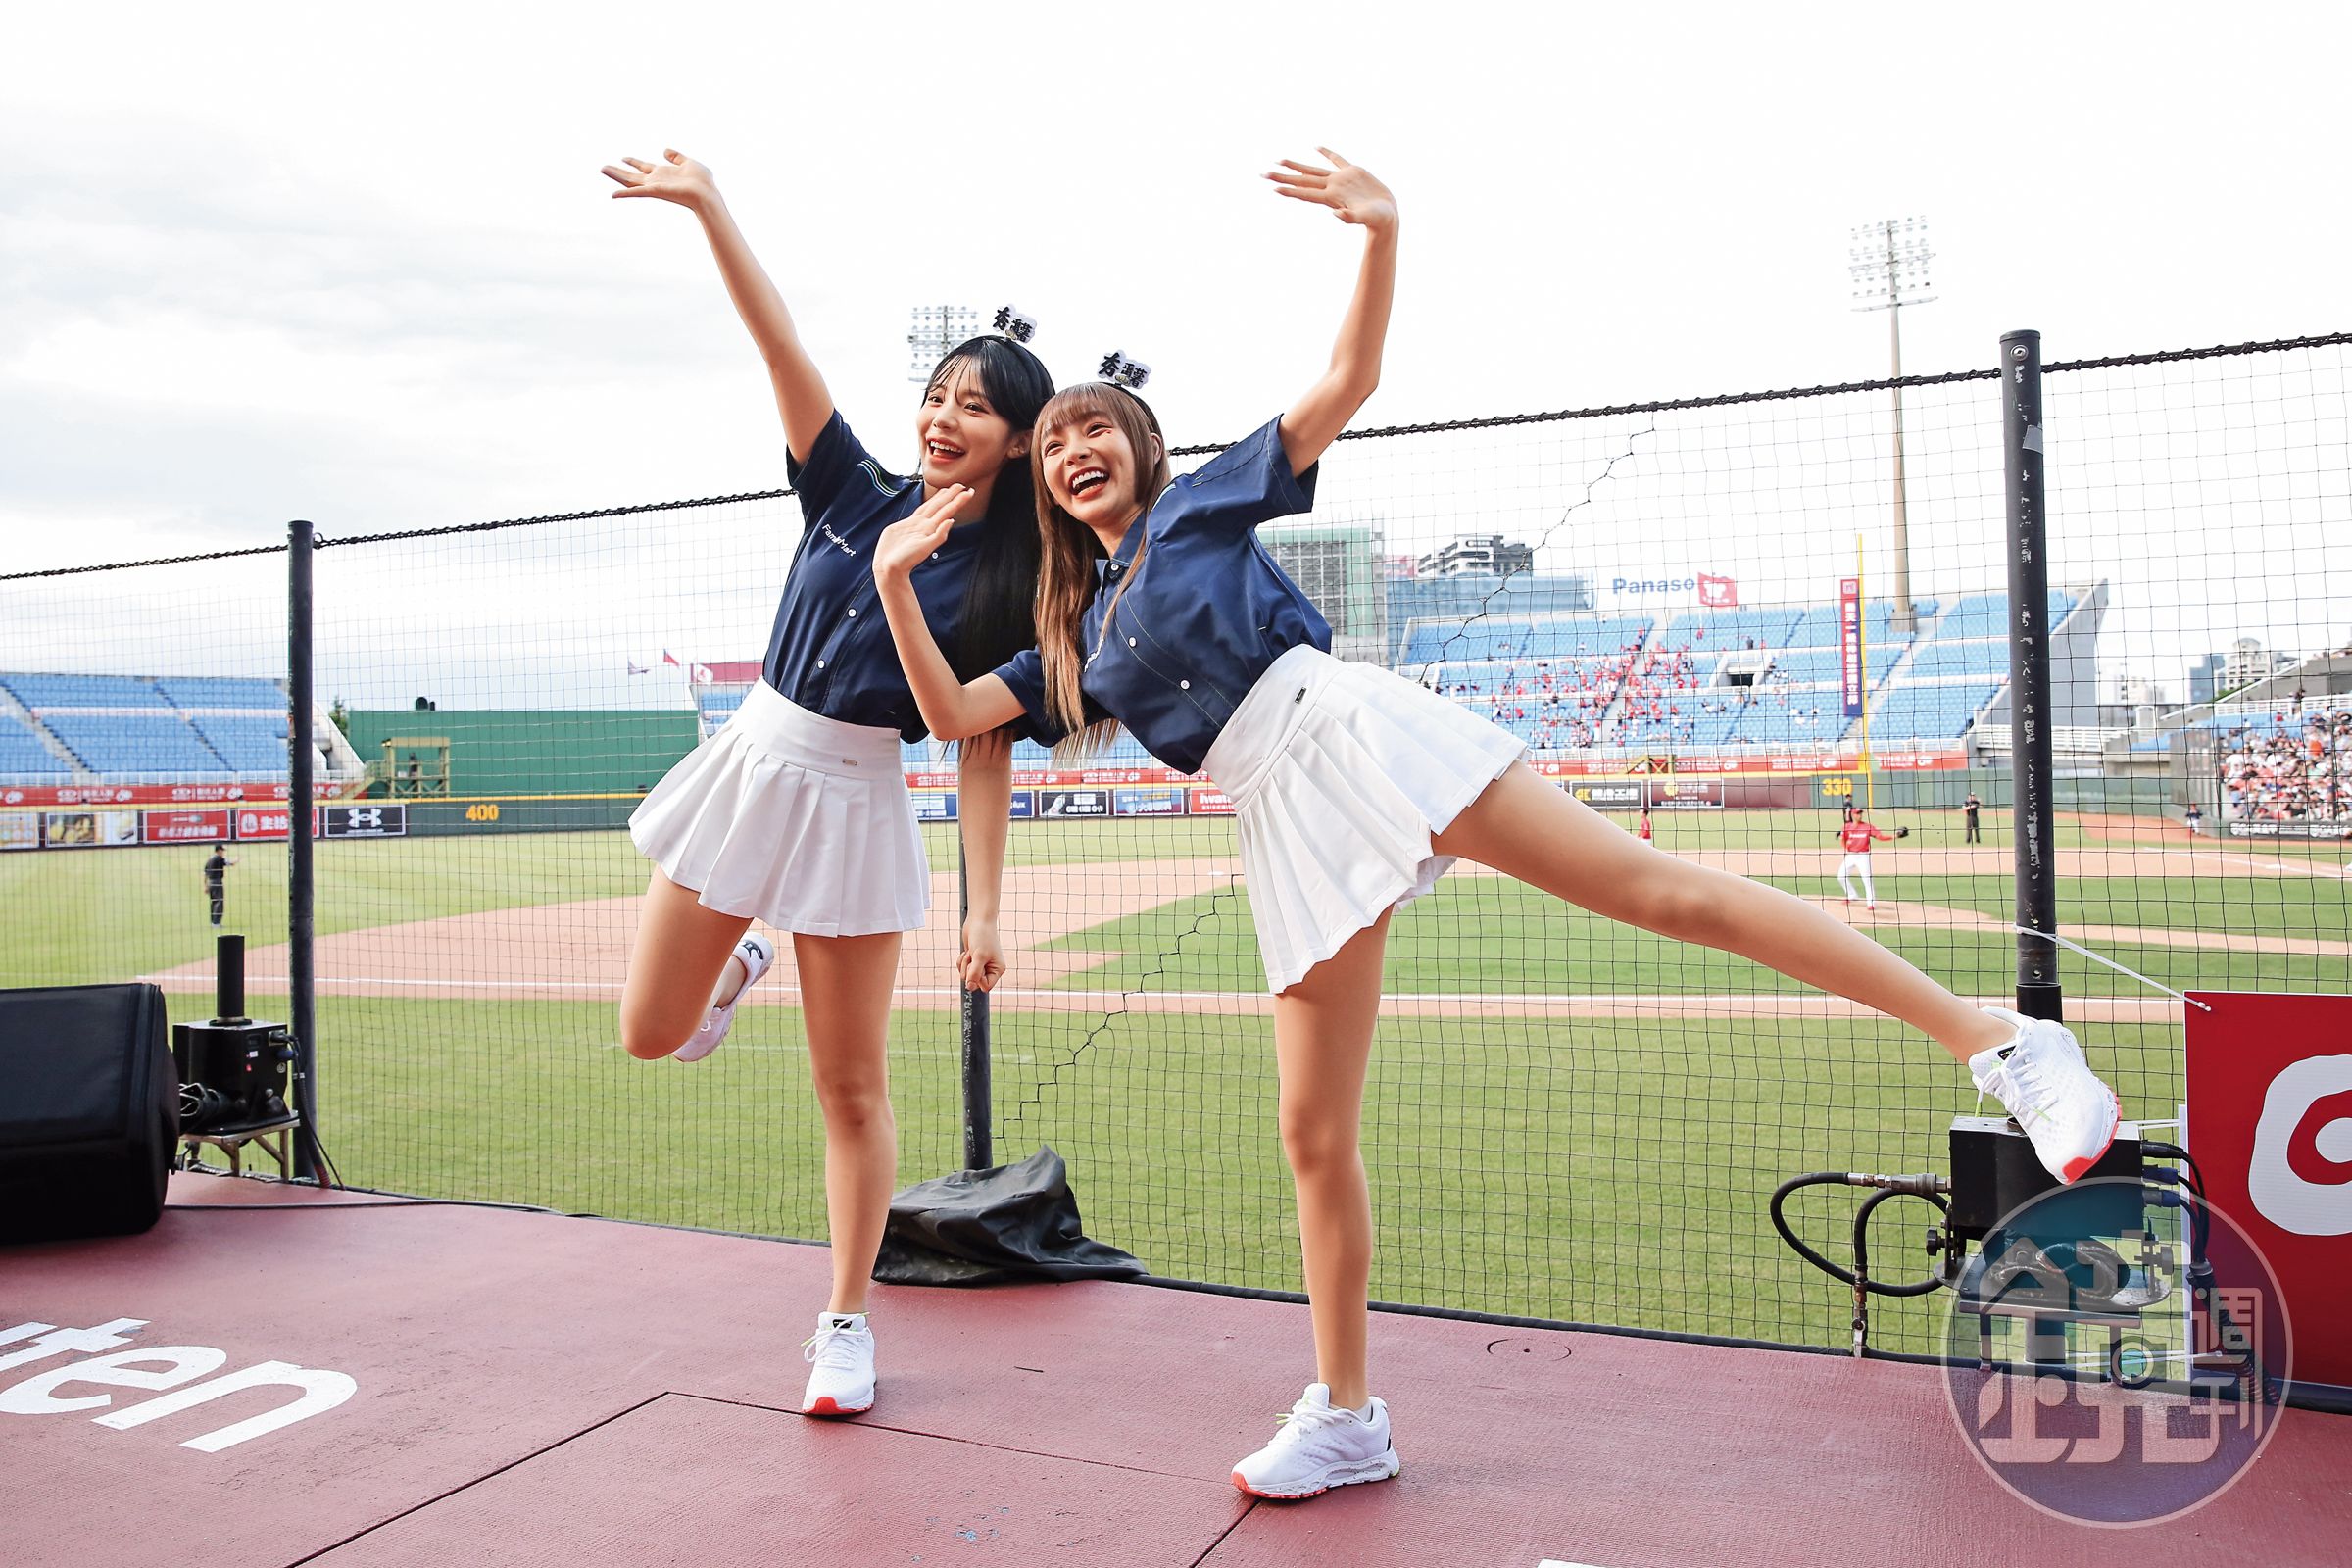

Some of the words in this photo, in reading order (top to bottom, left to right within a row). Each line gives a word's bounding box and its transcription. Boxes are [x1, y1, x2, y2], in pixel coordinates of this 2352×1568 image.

[1612, 578, 1695, 595] Panaso
[1822, 778, 1852, 796] 330
[1200, 793, 1232, 805] iwat
[466, 804, 500, 821] 400
[0, 1317, 358, 1453] ten
